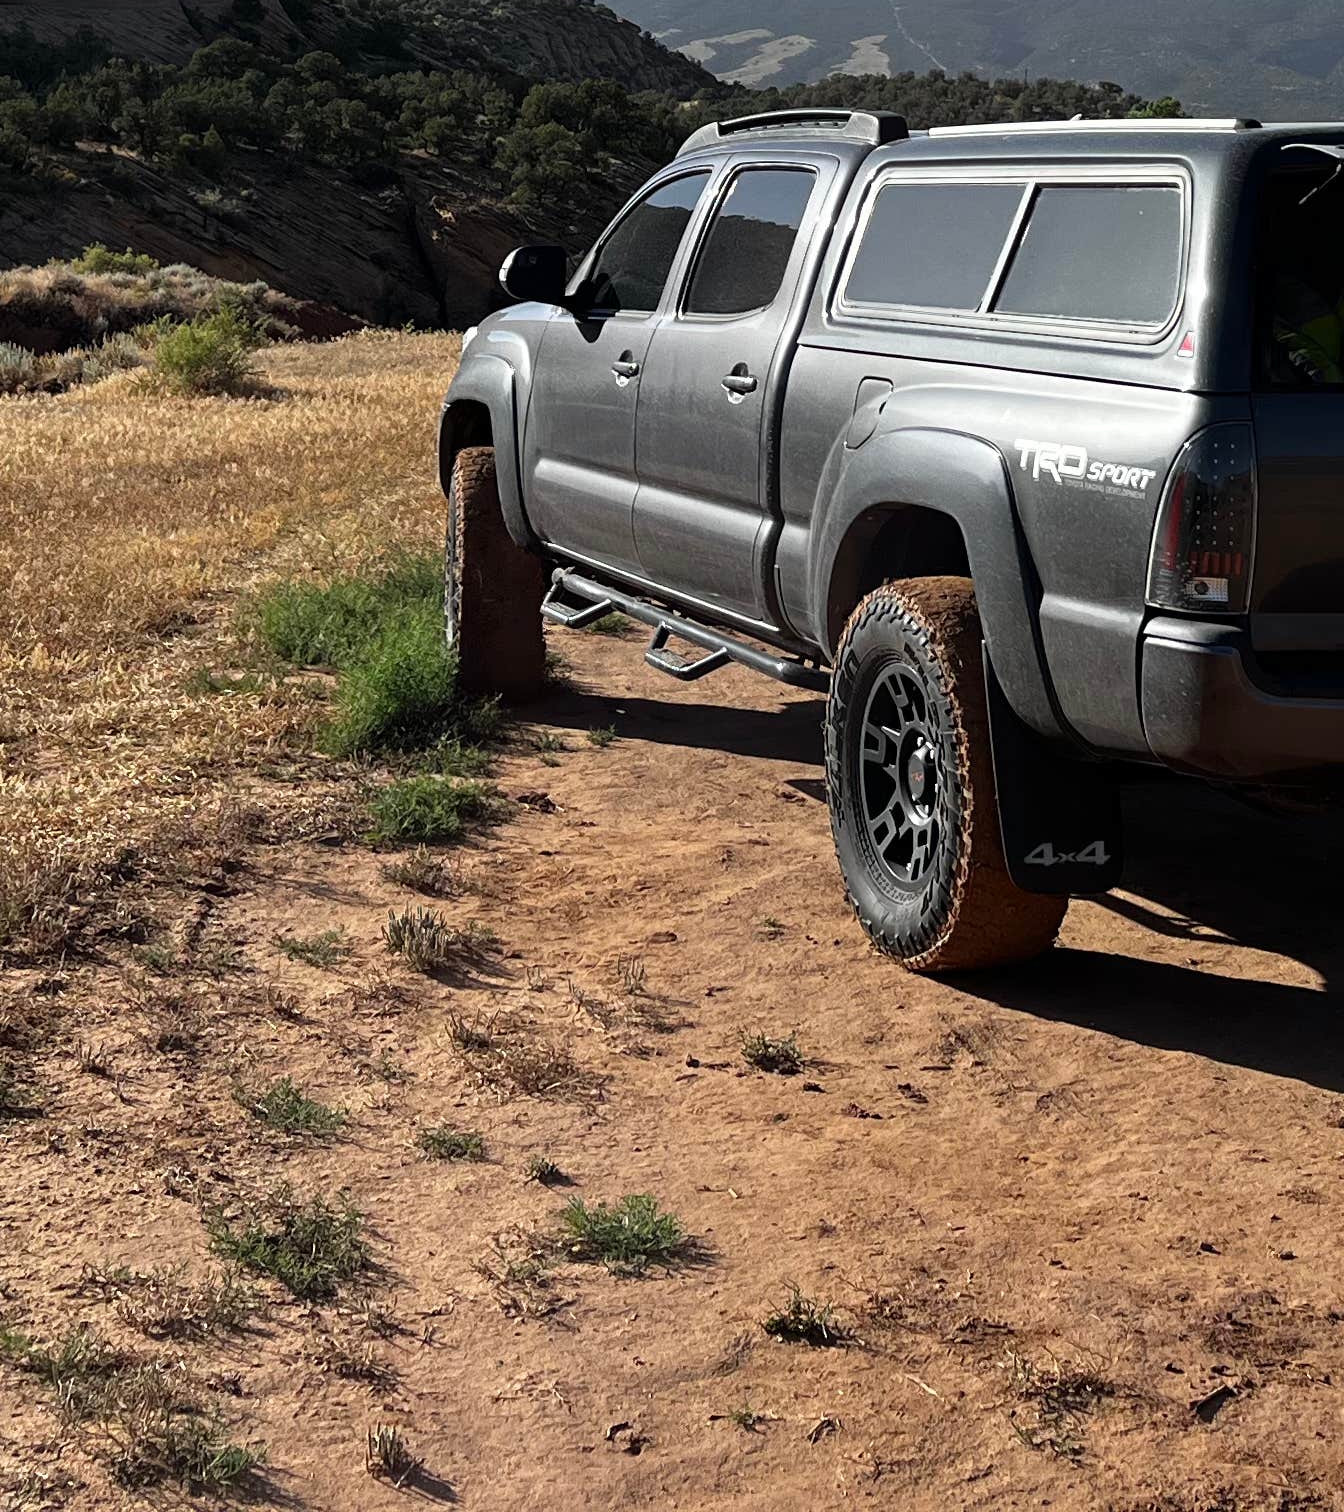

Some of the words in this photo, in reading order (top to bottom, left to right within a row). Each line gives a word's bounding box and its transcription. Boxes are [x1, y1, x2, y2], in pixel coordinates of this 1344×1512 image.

[1014, 438, 1087, 485] TRD
[1086, 461, 1157, 490] SPORT
[1023, 840, 1112, 867] 4x4
